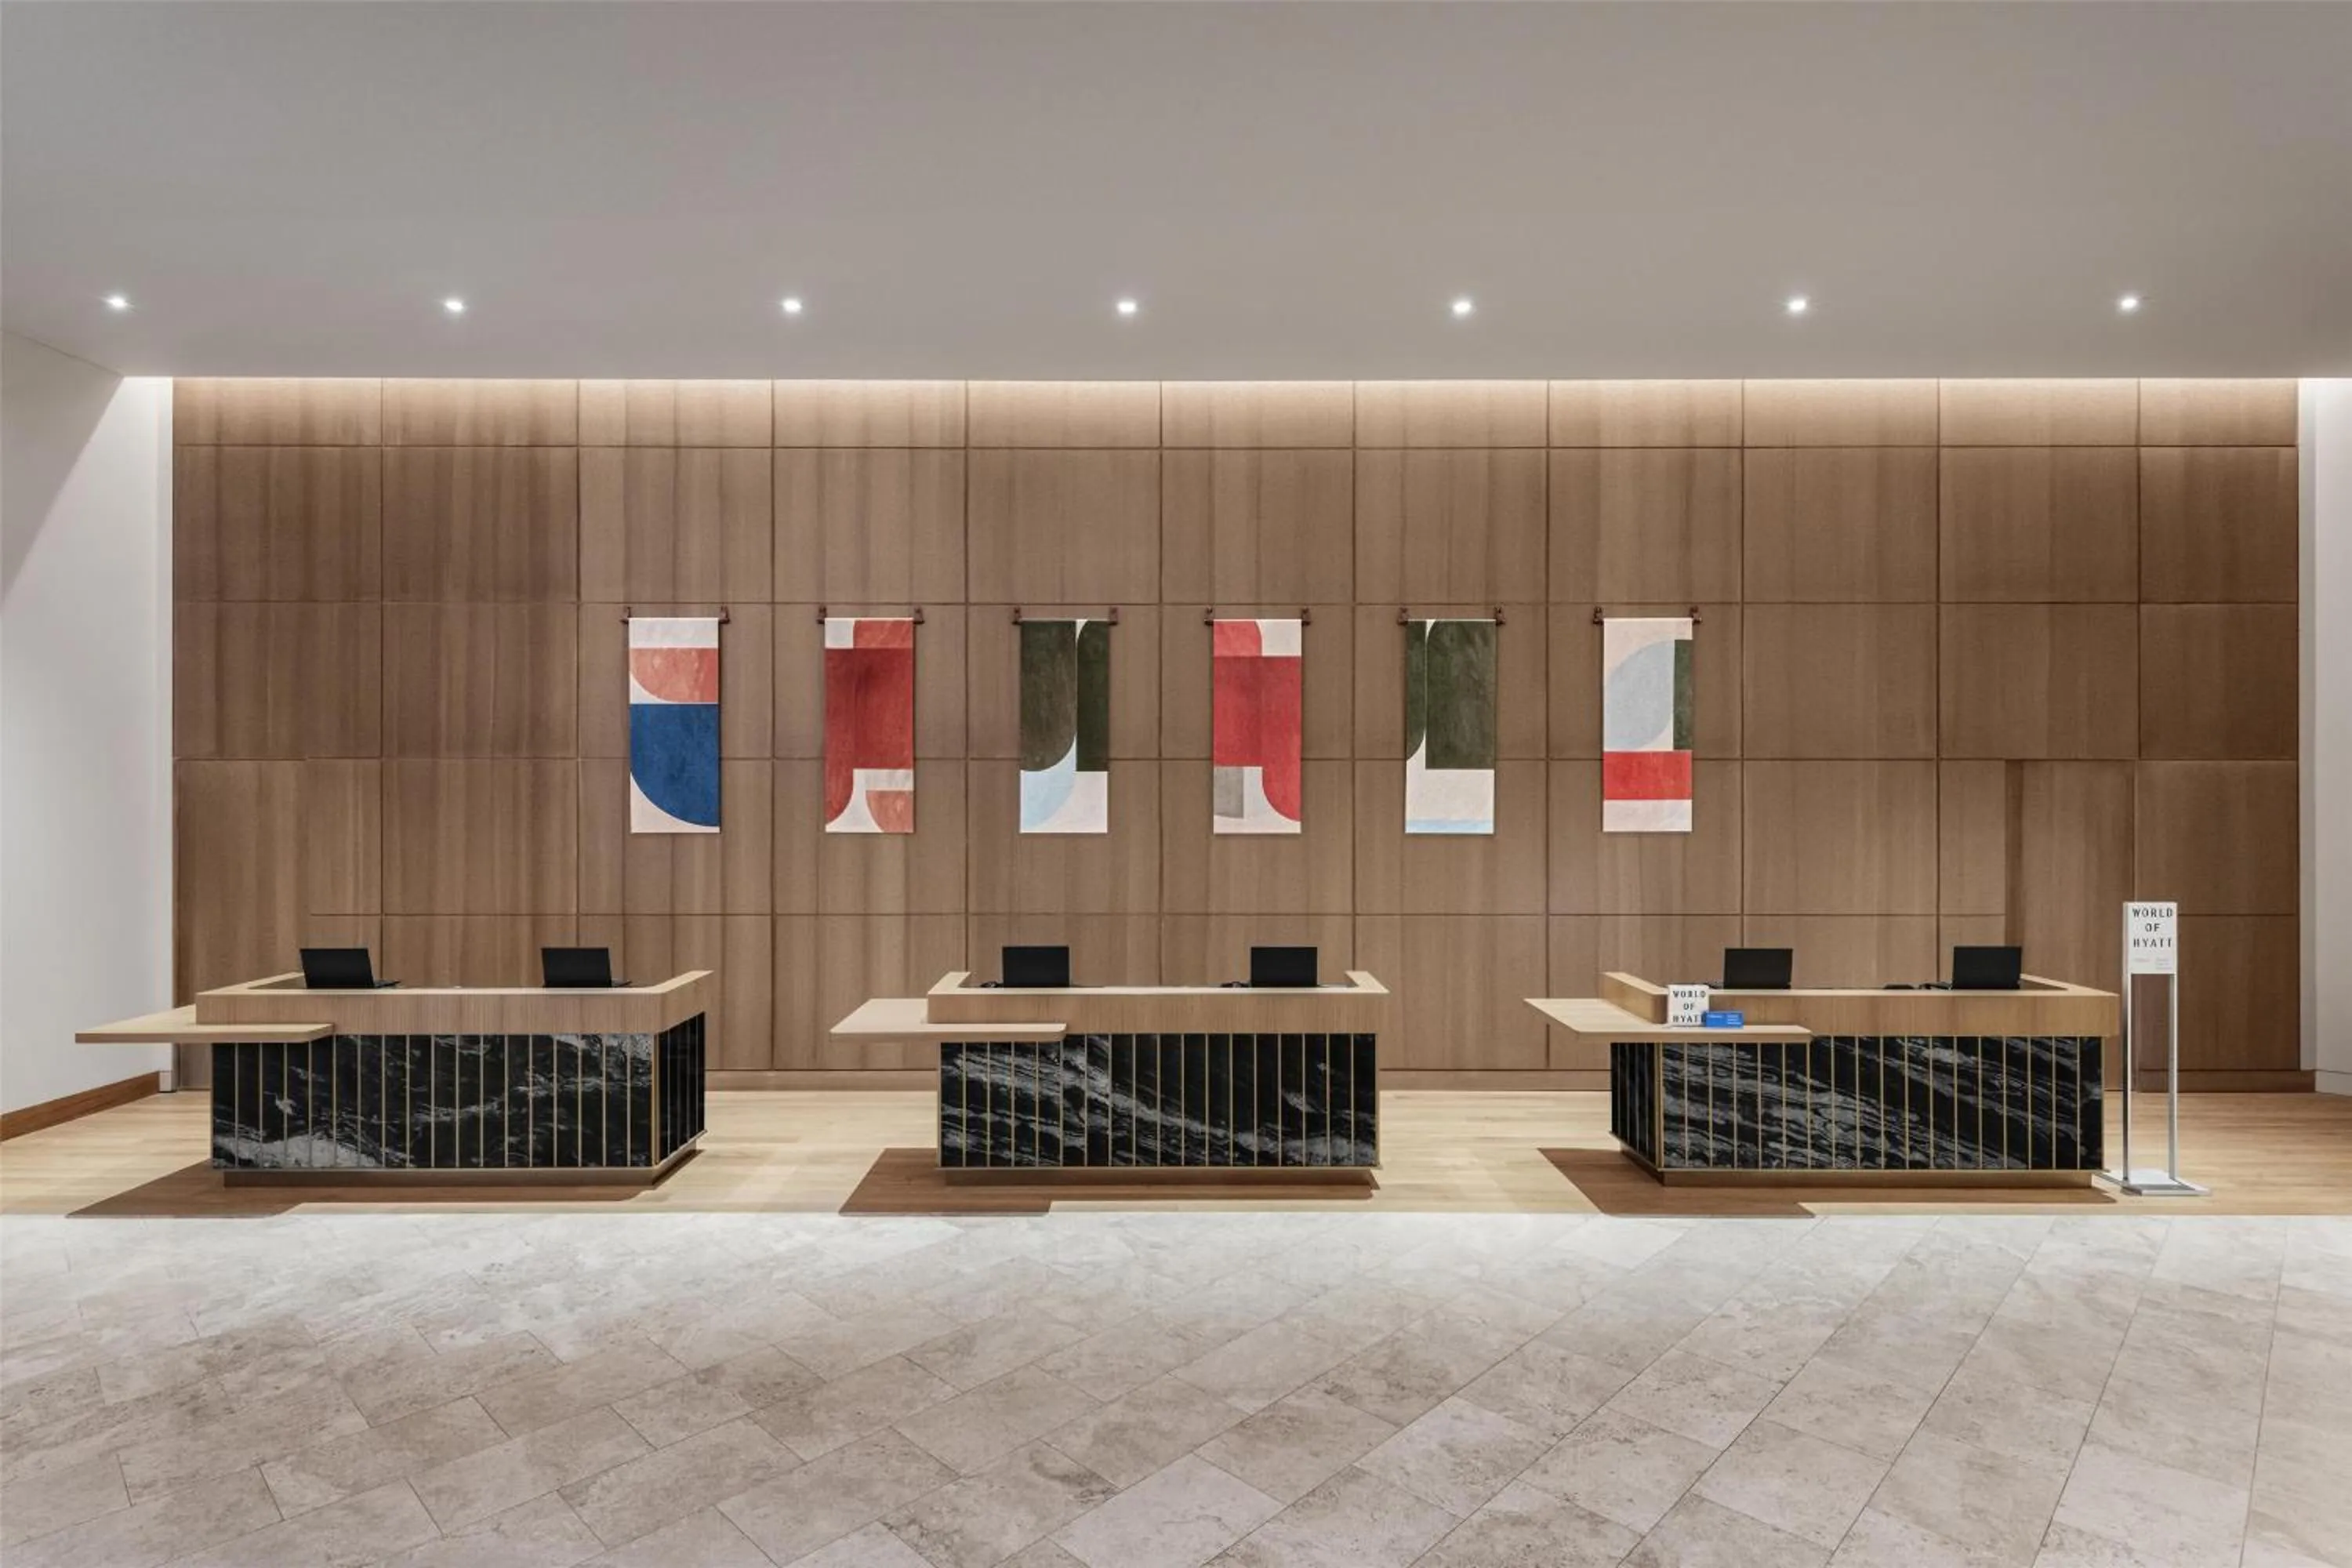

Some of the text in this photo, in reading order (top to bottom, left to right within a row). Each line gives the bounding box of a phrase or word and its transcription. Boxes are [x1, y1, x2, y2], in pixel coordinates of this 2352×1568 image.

[2132, 907, 2173, 917] WORLD
[2144, 923, 2161, 932] OF
[2133, 938, 2172, 948] HYATT
